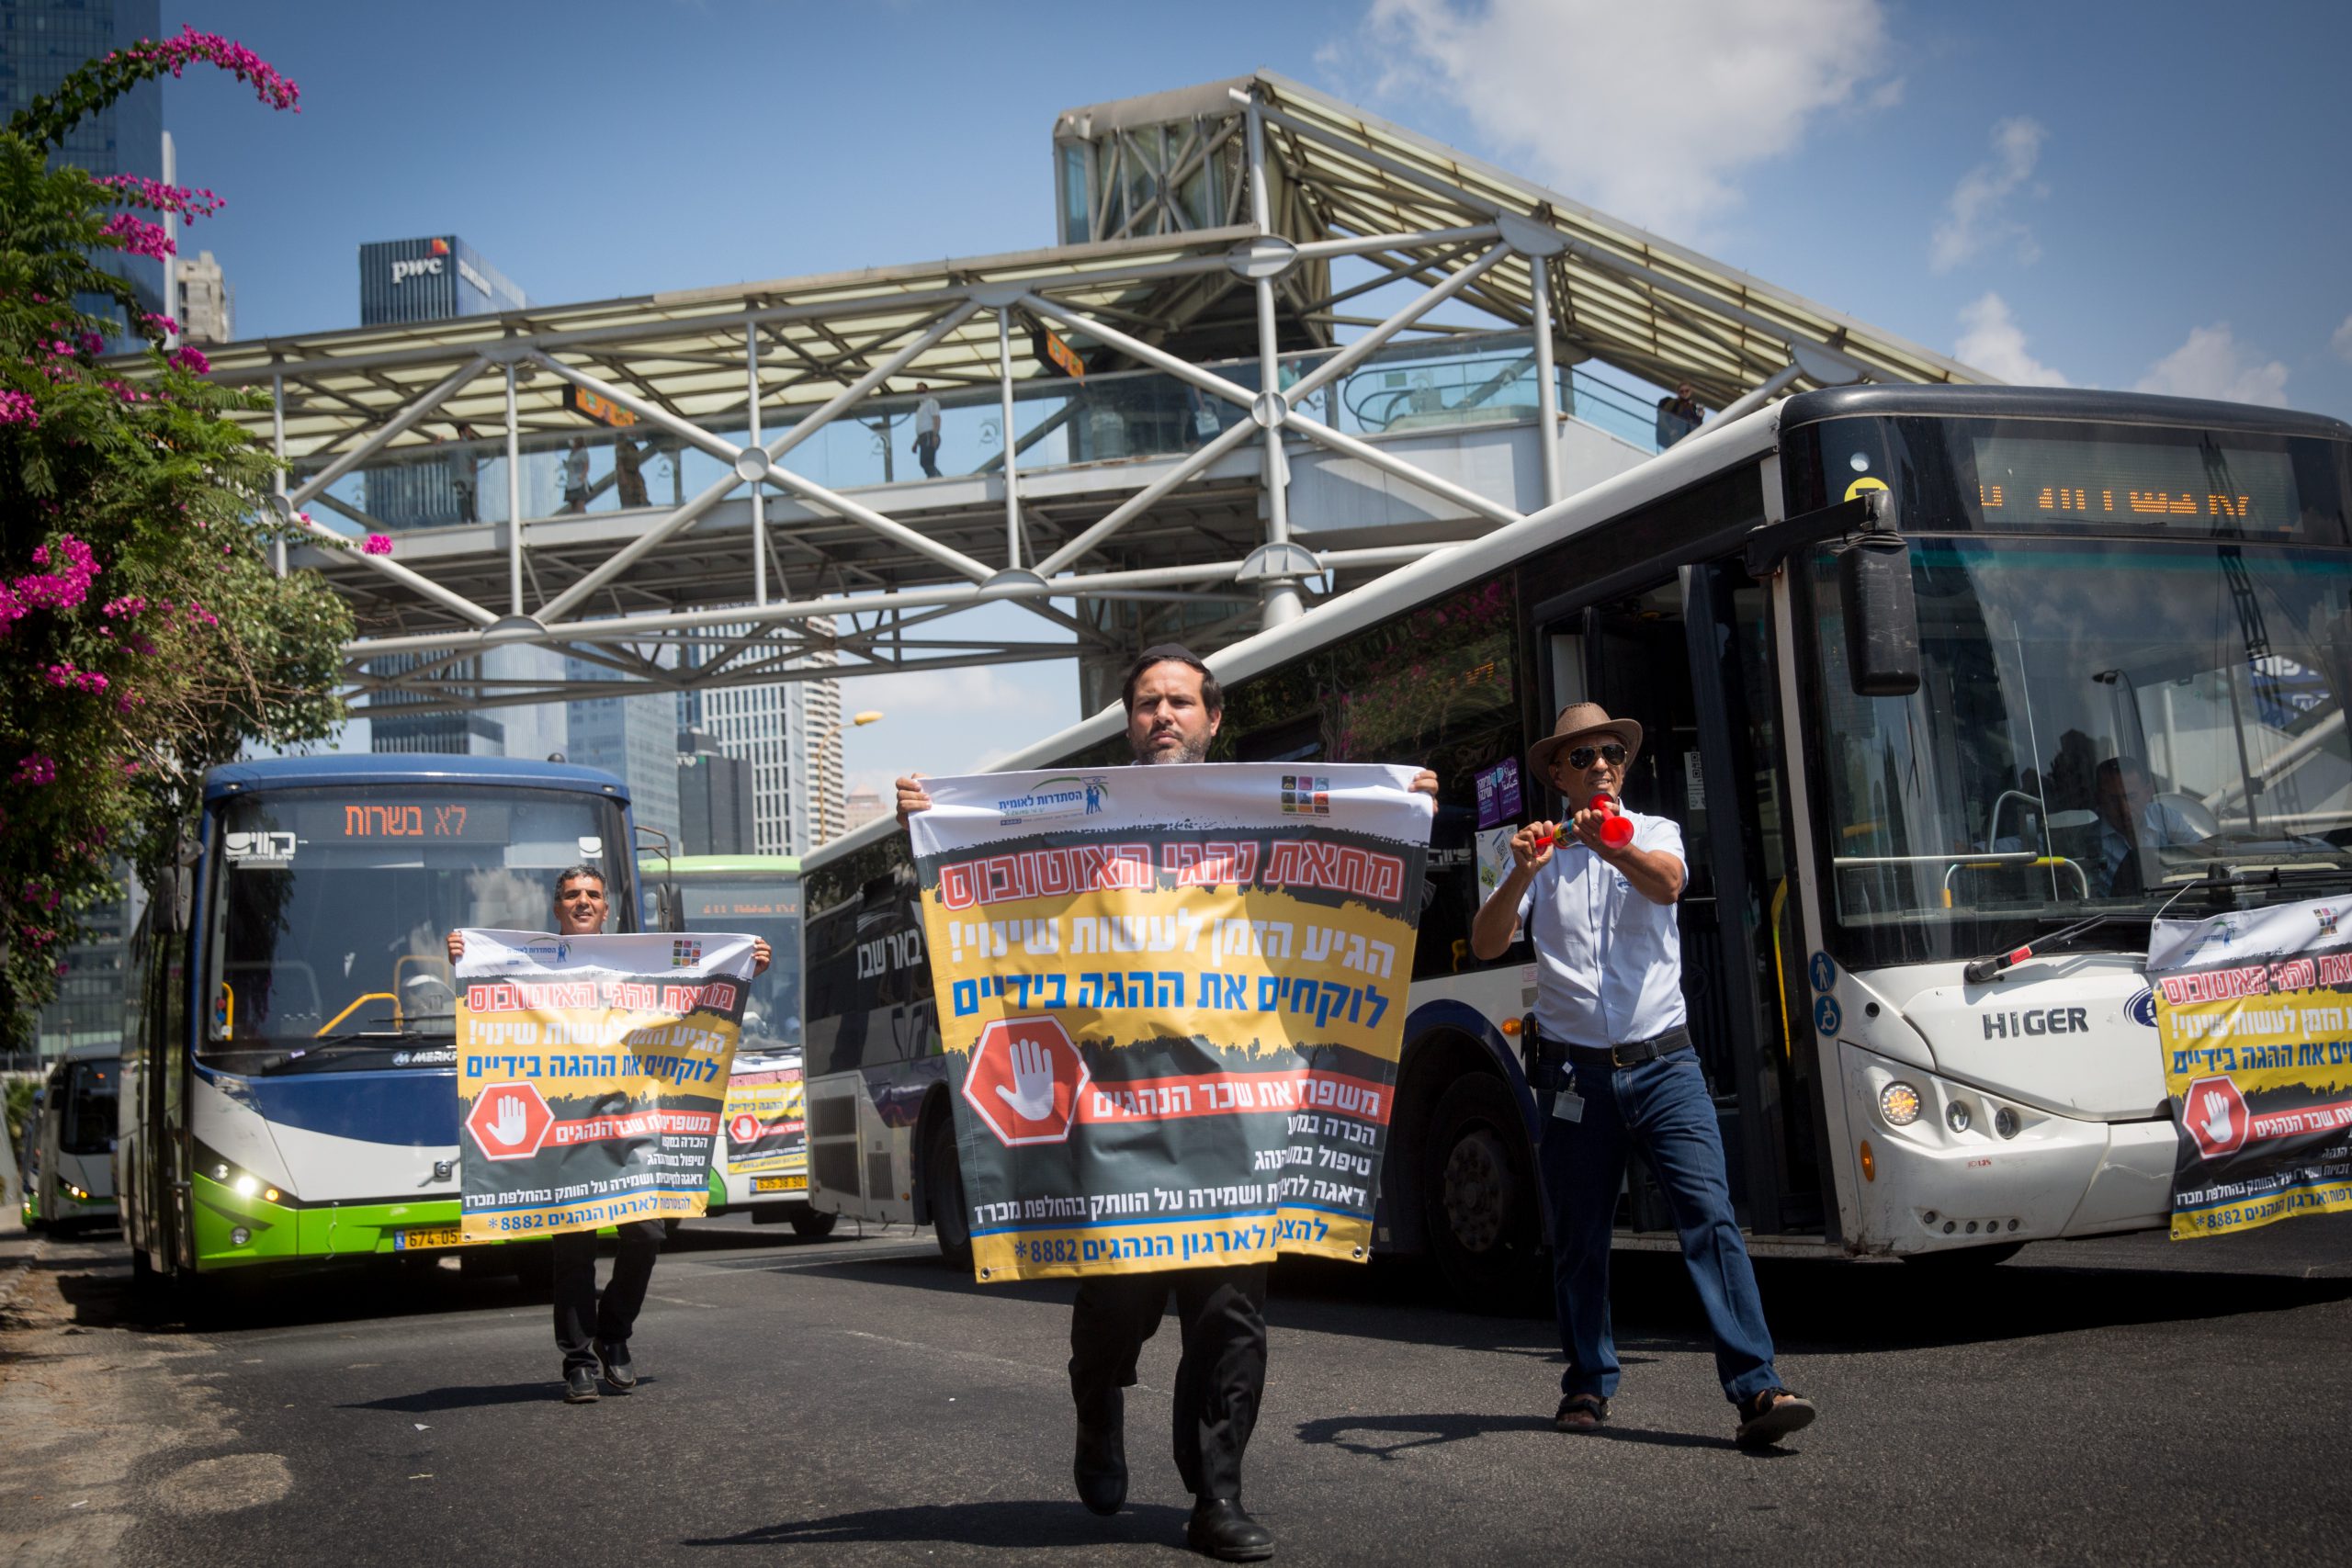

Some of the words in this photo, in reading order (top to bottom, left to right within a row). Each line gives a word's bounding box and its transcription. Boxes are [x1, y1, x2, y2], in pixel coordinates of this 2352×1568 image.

[391, 257, 442, 284] pwc
[999, 795, 1034, 809] לאומית
[1037, 791, 1082, 806] הסתדרות
[345, 806, 424, 836] בשרות
[435, 804, 467, 836] לא
[939, 842, 1154, 911] האוטובוס
[1161, 840, 1260, 887] נהגי
[1263, 840, 1405, 903] מחאת
[949, 919, 1060, 963] שינוי!
[1069, 908, 1203, 953] לעשות
[1211, 917, 1294, 967] הזמן
[1301, 925, 1396, 979] הגיע
[2160, 965, 2268, 1006] האוטובוס
[2270, 958, 2315, 991] נהגי
[468, 982, 598, 1013] האוטובוס
[602, 982, 658, 1010] נהגי
[953, 974, 1067, 1017] בידיים
[1078, 971, 1184, 1009] ההגה
[1196, 972, 1248, 1010] את
[1257, 976, 1389, 1029] לוקחים
[469, 1020, 537, 1045] שינוי!
[1983, 1008, 2089, 1040] HIGER
[2170, 1011, 2229, 1039] שינוי!
[2233, 1005, 2296, 1035] לעשות
[2301, 1007, 2343, 1040] הזמן
[671, 1028, 726, 1055] הגיע
[2298, 1043, 2325, 1066] את
[467, 1055, 542, 1077] בידיים
[549, 1055, 616, 1077] ההגה
[621, 1055, 641, 1077] את
[2173, 1048, 2237, 1073] בידיים
[2242, 1044, 2293, 1069] ההגה
[645, 1056, 719, 1086] לוקחים
[1093, 1086, 1192, 1118] הנהגים
[1199, 1080, 1255, 1110] שכר
[1257, 1080, 1295, 1107] את
[556, 1121, 613, 1143] הנהגים
[616, 1117, 646, 1134] שכר
[1324, 1117, 1375, 1145] הכרה
[2254, 1116, 2302, 1138] הנהגים
[2303, 1111, 2335, 1129] שכר
[681, 1137, 708, 1148] הכרה
[680, 1153, 706, 1167] טיפול
[1318, 1145, 1371, 1176] טיפול
[555, 1184, 589, 1203] הוותק
[591, 1179, 608, 1193] על
[610, 1173, 654, 1191] ושמירה
[1312, 1179, 1366, 1206] דאגה
[2205, 1183, 2246, 1201] בהחלפת
[465, 1193, 496, 1207] מכרז
[498, 1188, 552, 1205] בהחלפת
[608, 1196, 658, 1220] לארגון
[1024, 1195, 1086, 1218] בהחלפת
[1091, 1192, 1149, 1222] הוותק
[1154, 1187, 1182, 1211] על
[1190, 1183, 1262, 1210] ושמירה
[2177, 1190, 2203, 1205] מכרז
[2245, 1199, 2285, 1221] הנהגים
[548, 1207, 604, 1226] הנהגים
[974, 1201, 1021, 1224] מכרז
[1083, 1235, 1174, 1261] הנהגים
[1182, 1224, 1265, 1260] לארגון
